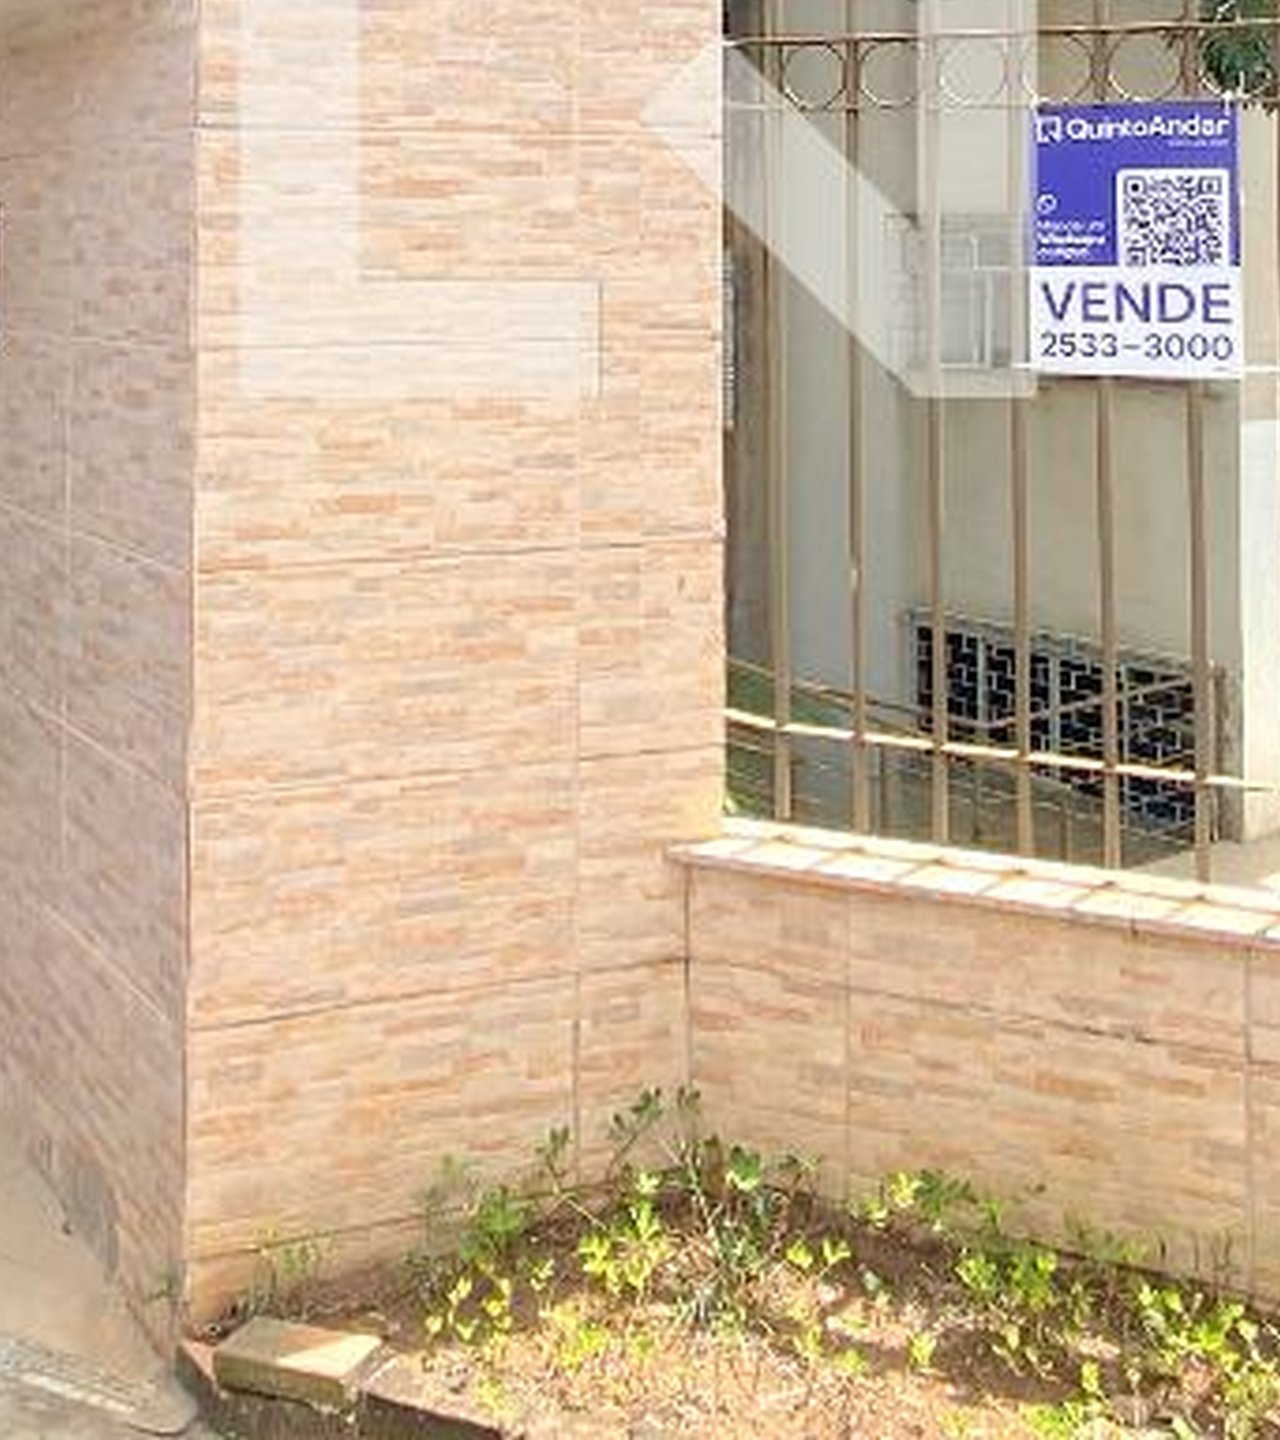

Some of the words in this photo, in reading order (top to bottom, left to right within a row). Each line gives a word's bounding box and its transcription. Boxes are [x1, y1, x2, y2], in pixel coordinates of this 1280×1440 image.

[1067, 115, 1230, 141] QuintoAndar
[1041, 283, 1233, 324] VENDE
[1041, 332, 1234, 361] 2533-3000
